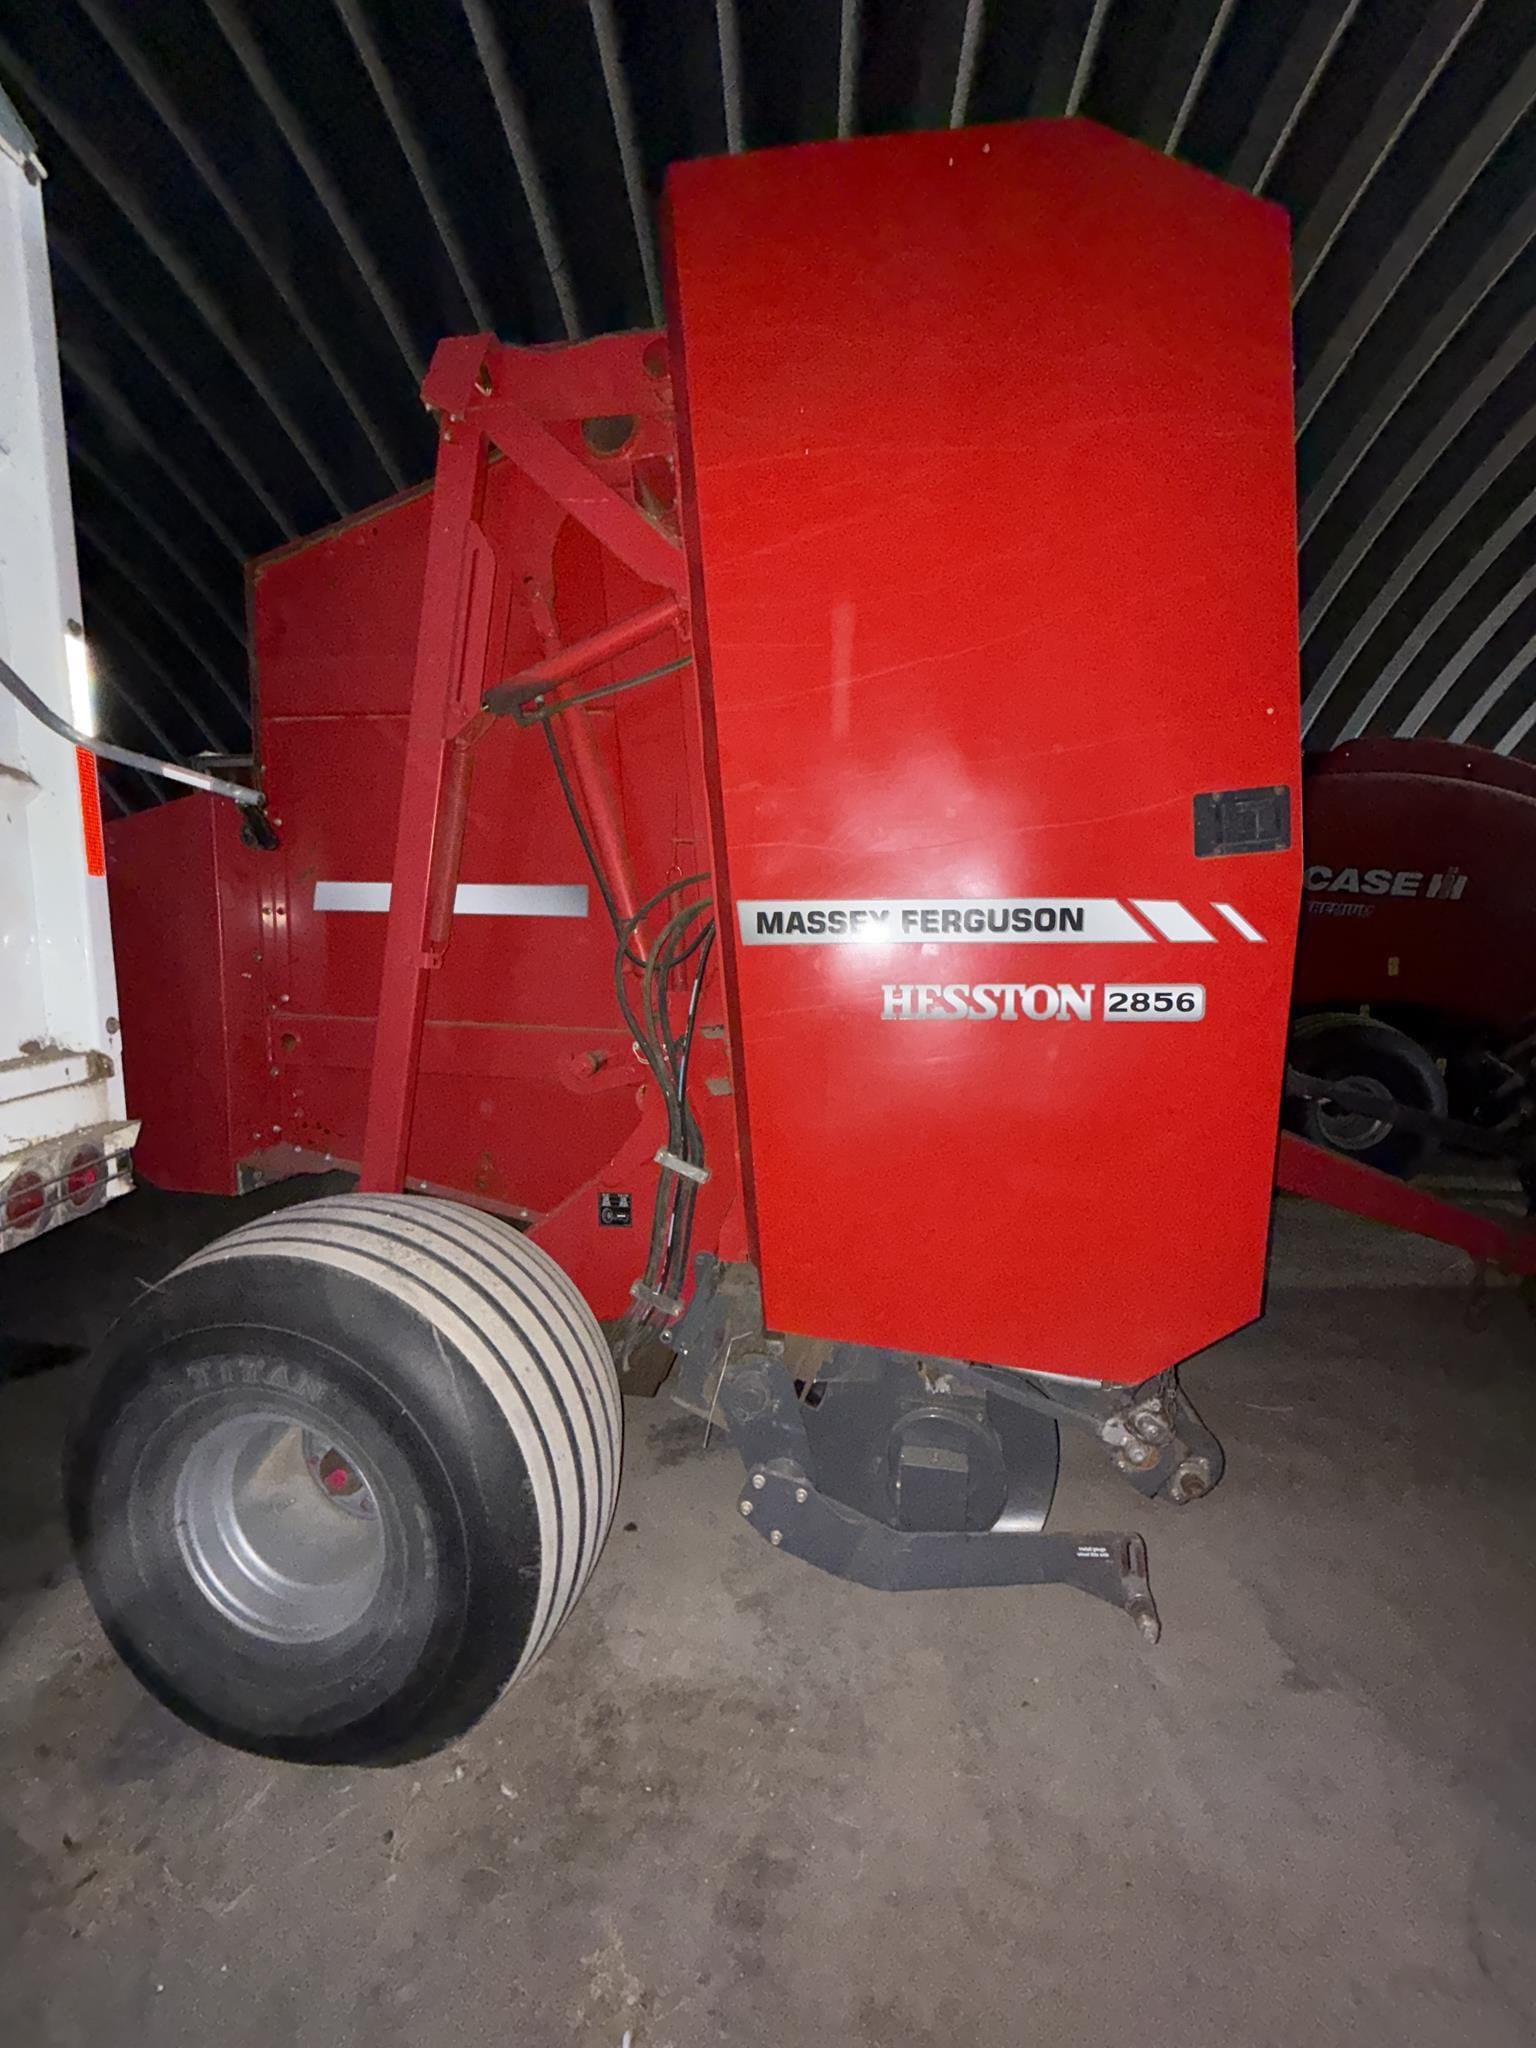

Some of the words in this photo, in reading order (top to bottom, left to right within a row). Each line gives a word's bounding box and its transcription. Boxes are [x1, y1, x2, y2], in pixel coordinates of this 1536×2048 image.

[1303, 865, 1424, 897] CASE
[901, 907, 1084, 934] FERGUSON
[881, 983, 1095, 1021] HESSTON
[1108, 992, 1196, 1013] 2856
[185, 1357, 329, 1402] TITAN
